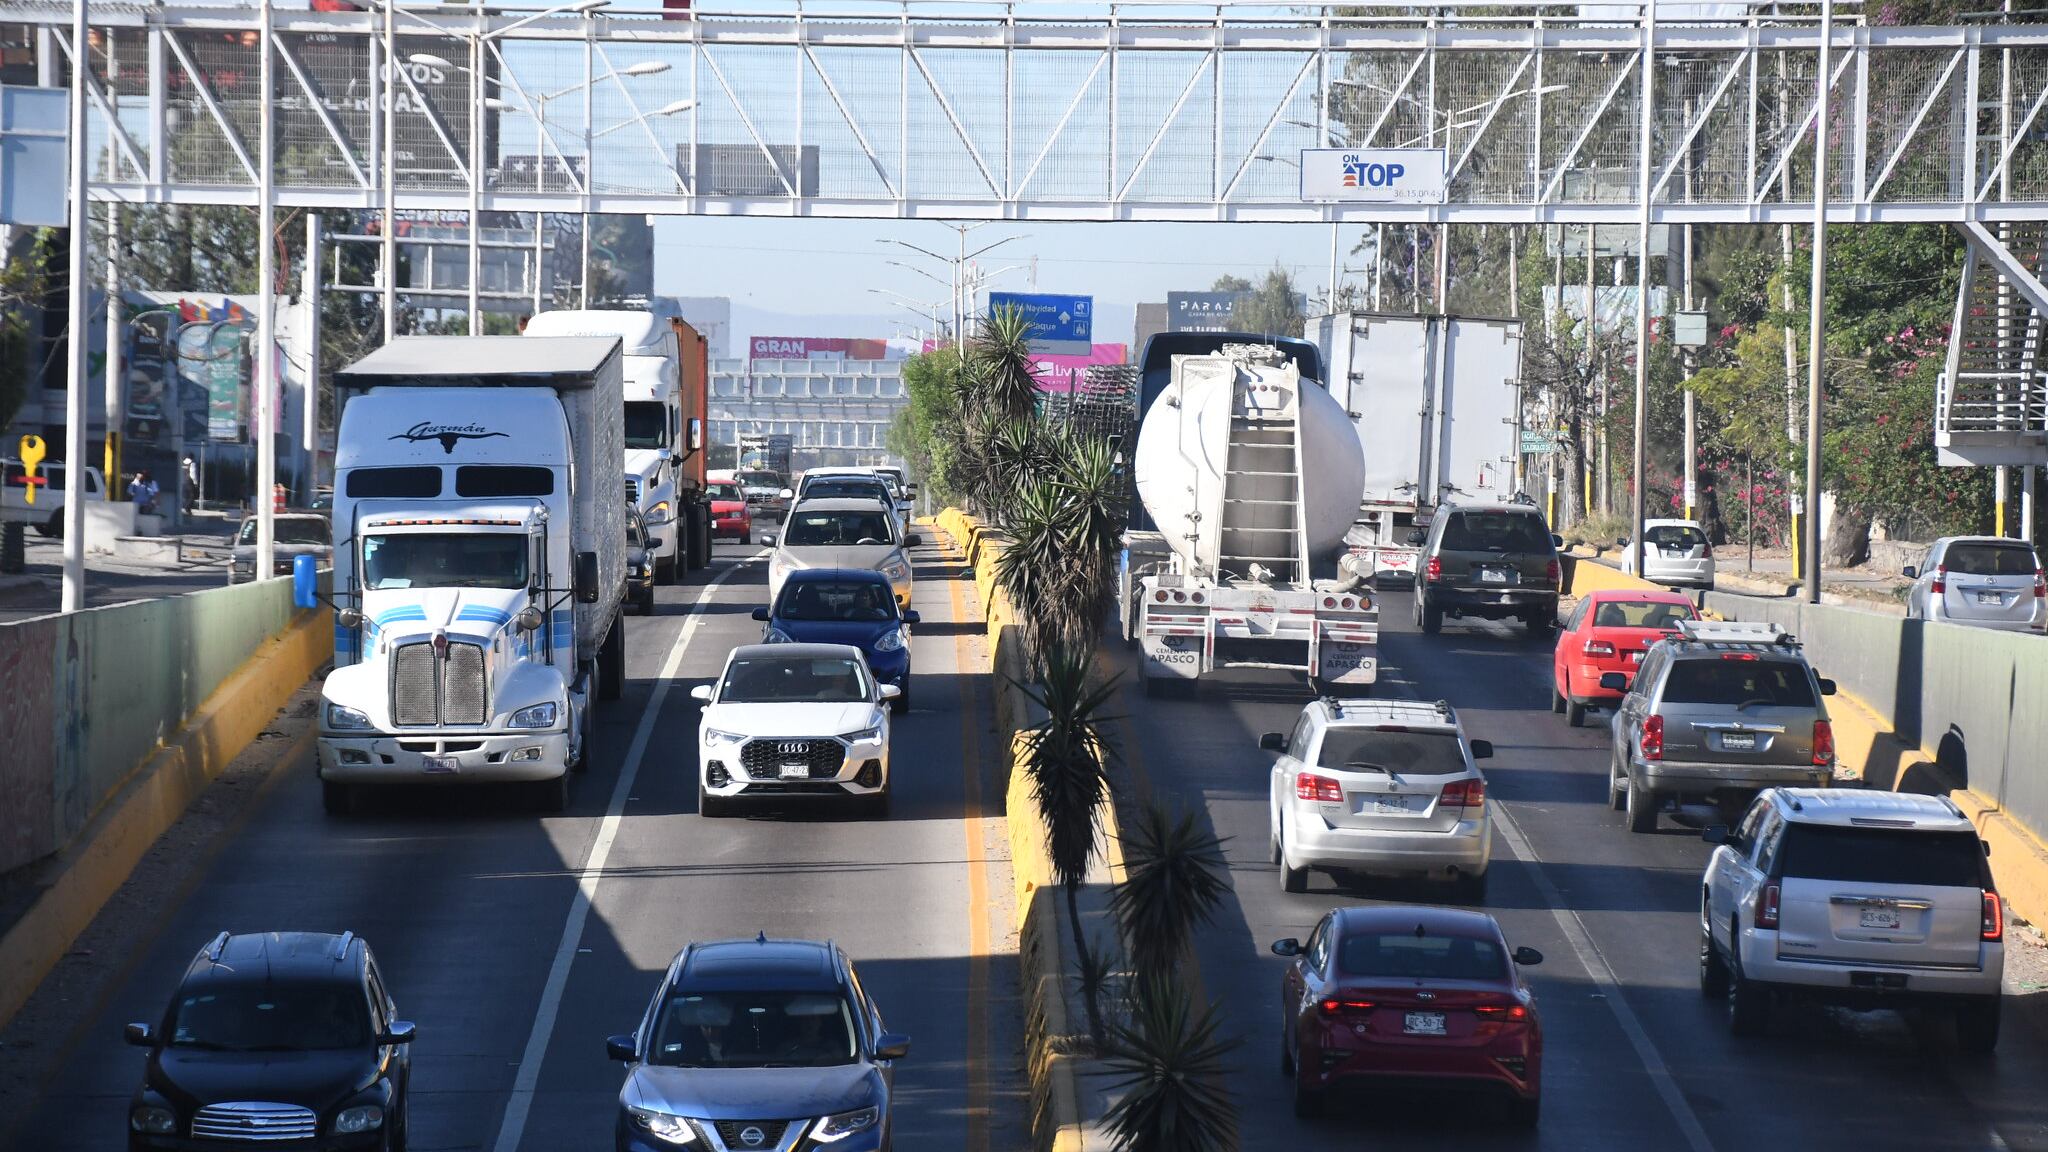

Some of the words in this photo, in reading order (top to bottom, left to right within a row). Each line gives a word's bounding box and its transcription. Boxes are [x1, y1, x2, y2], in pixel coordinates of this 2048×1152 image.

[1342, 154, 1359, 163] ON
[1353, 163, 1405, 187] TOP
[1026, 304, 1057, 314] Navidad
[1180, 300, 1233, 311] PARAJ
[754, 340, 805, 354] GRAN
[406, 421, 486, 443] Guzmán
[1150, 654, 1196, 664] APASCO
[1326, 660, 1372, 670] APASCO
